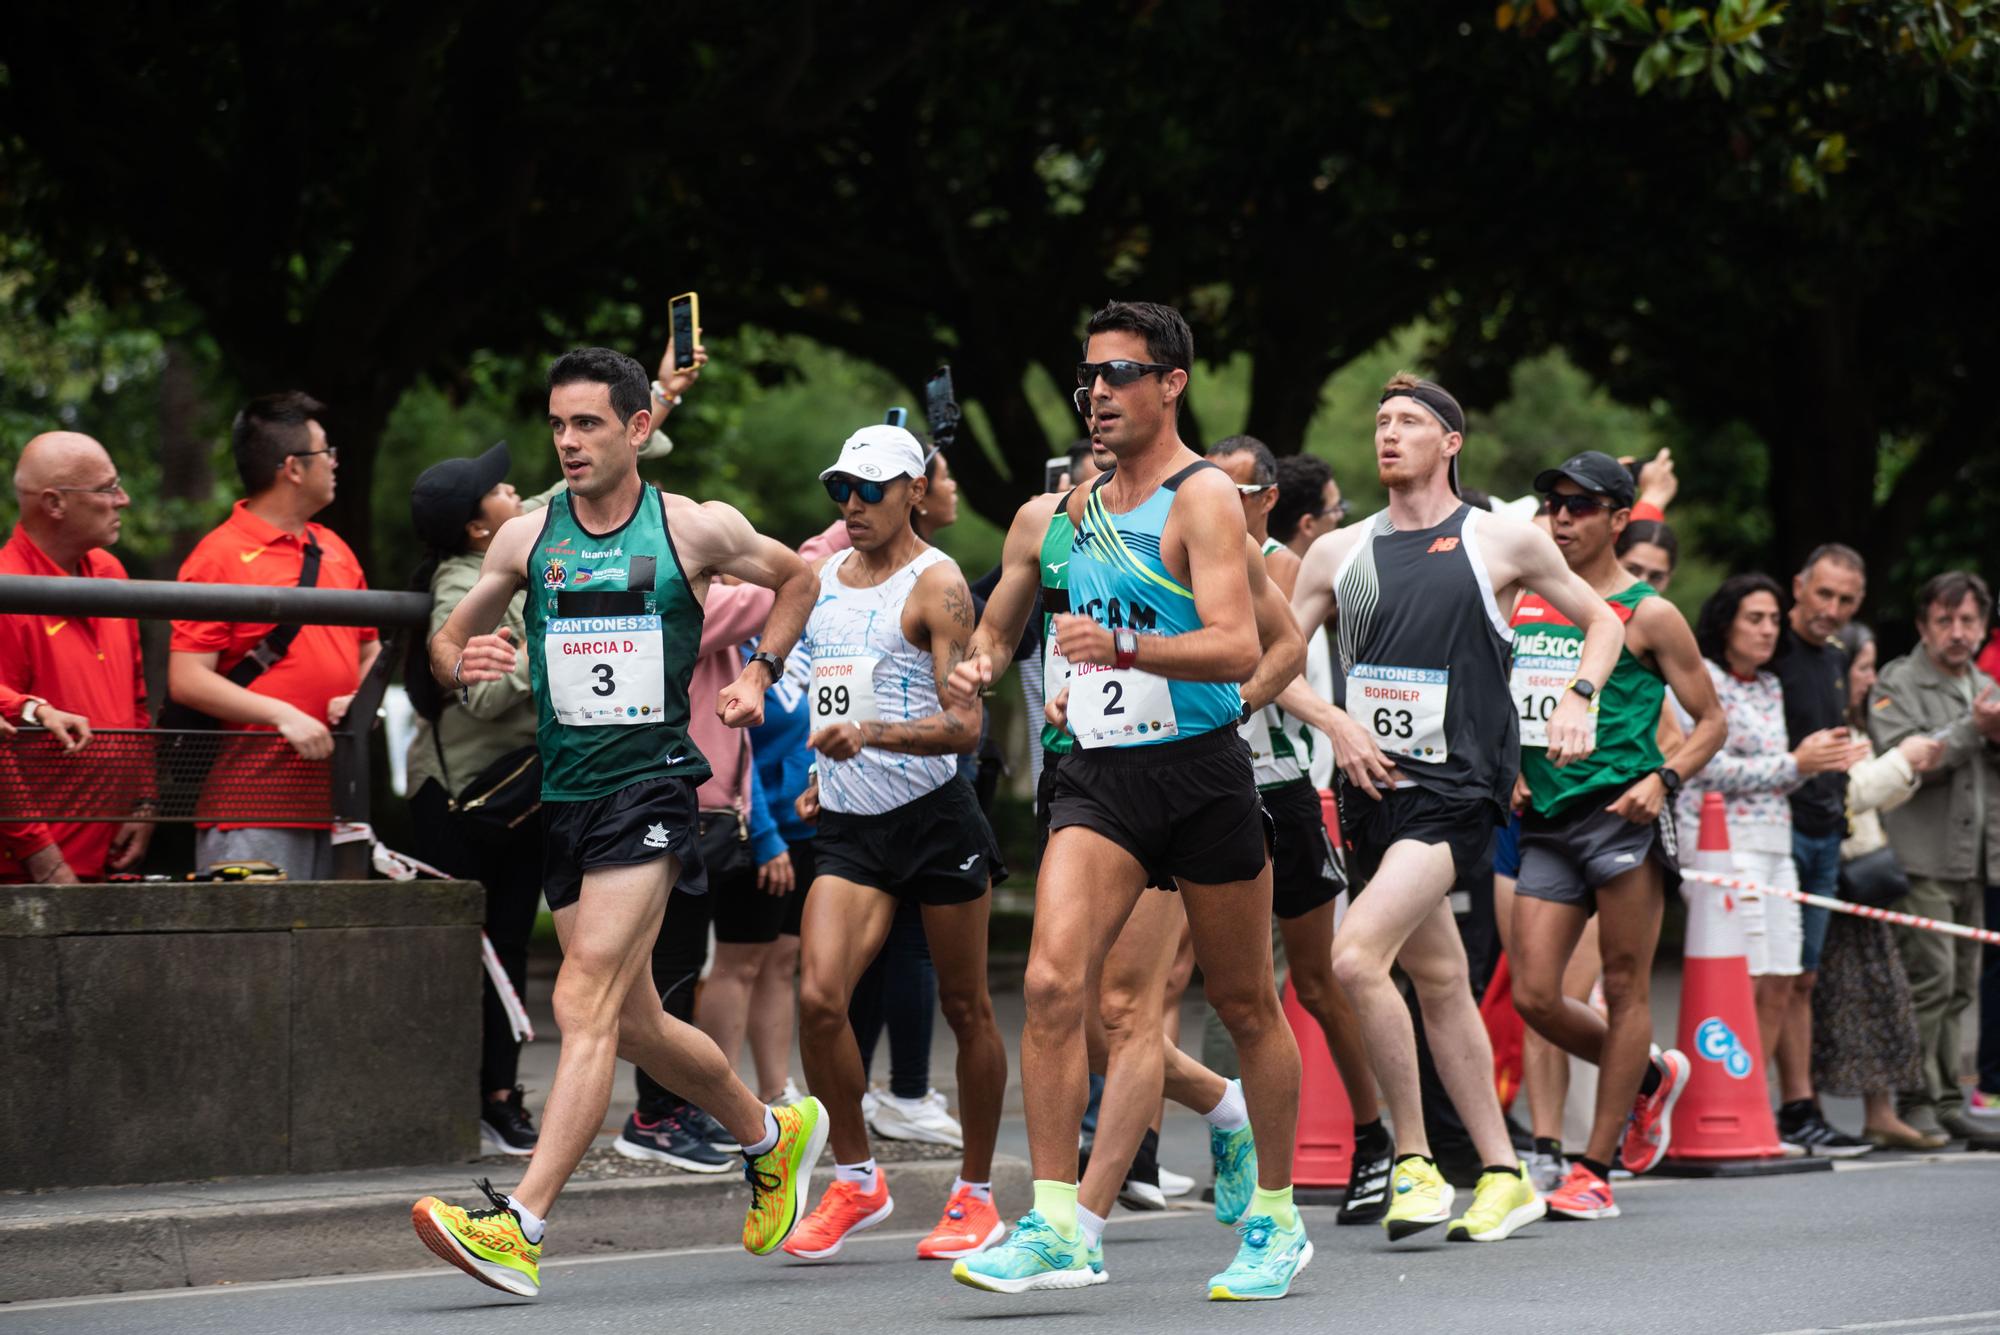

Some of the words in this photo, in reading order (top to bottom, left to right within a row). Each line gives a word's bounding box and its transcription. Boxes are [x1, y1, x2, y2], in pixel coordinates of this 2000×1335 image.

[581, 549, 613, 559] luanvi
[552, 616, 657, 633] CANTONES23
[1071, 597, 1157, 630] CAM
[563, 641, 618, 655] GARCIA
[623, 640, 638, 653] D.
[591, 663, 616, 697] 3
[816, 664, 853, 678] DOCTOR
[1353, 665, 1445, 684] CANTONES23
[817, 685, 850, 716] 89
[1102, 680, 1125, 716] 2
[1364, 686, 1420, 702] BORDIER
[1373, 707, 1414, 739] 63
[458, 1225, 515, 1253] SPEED
